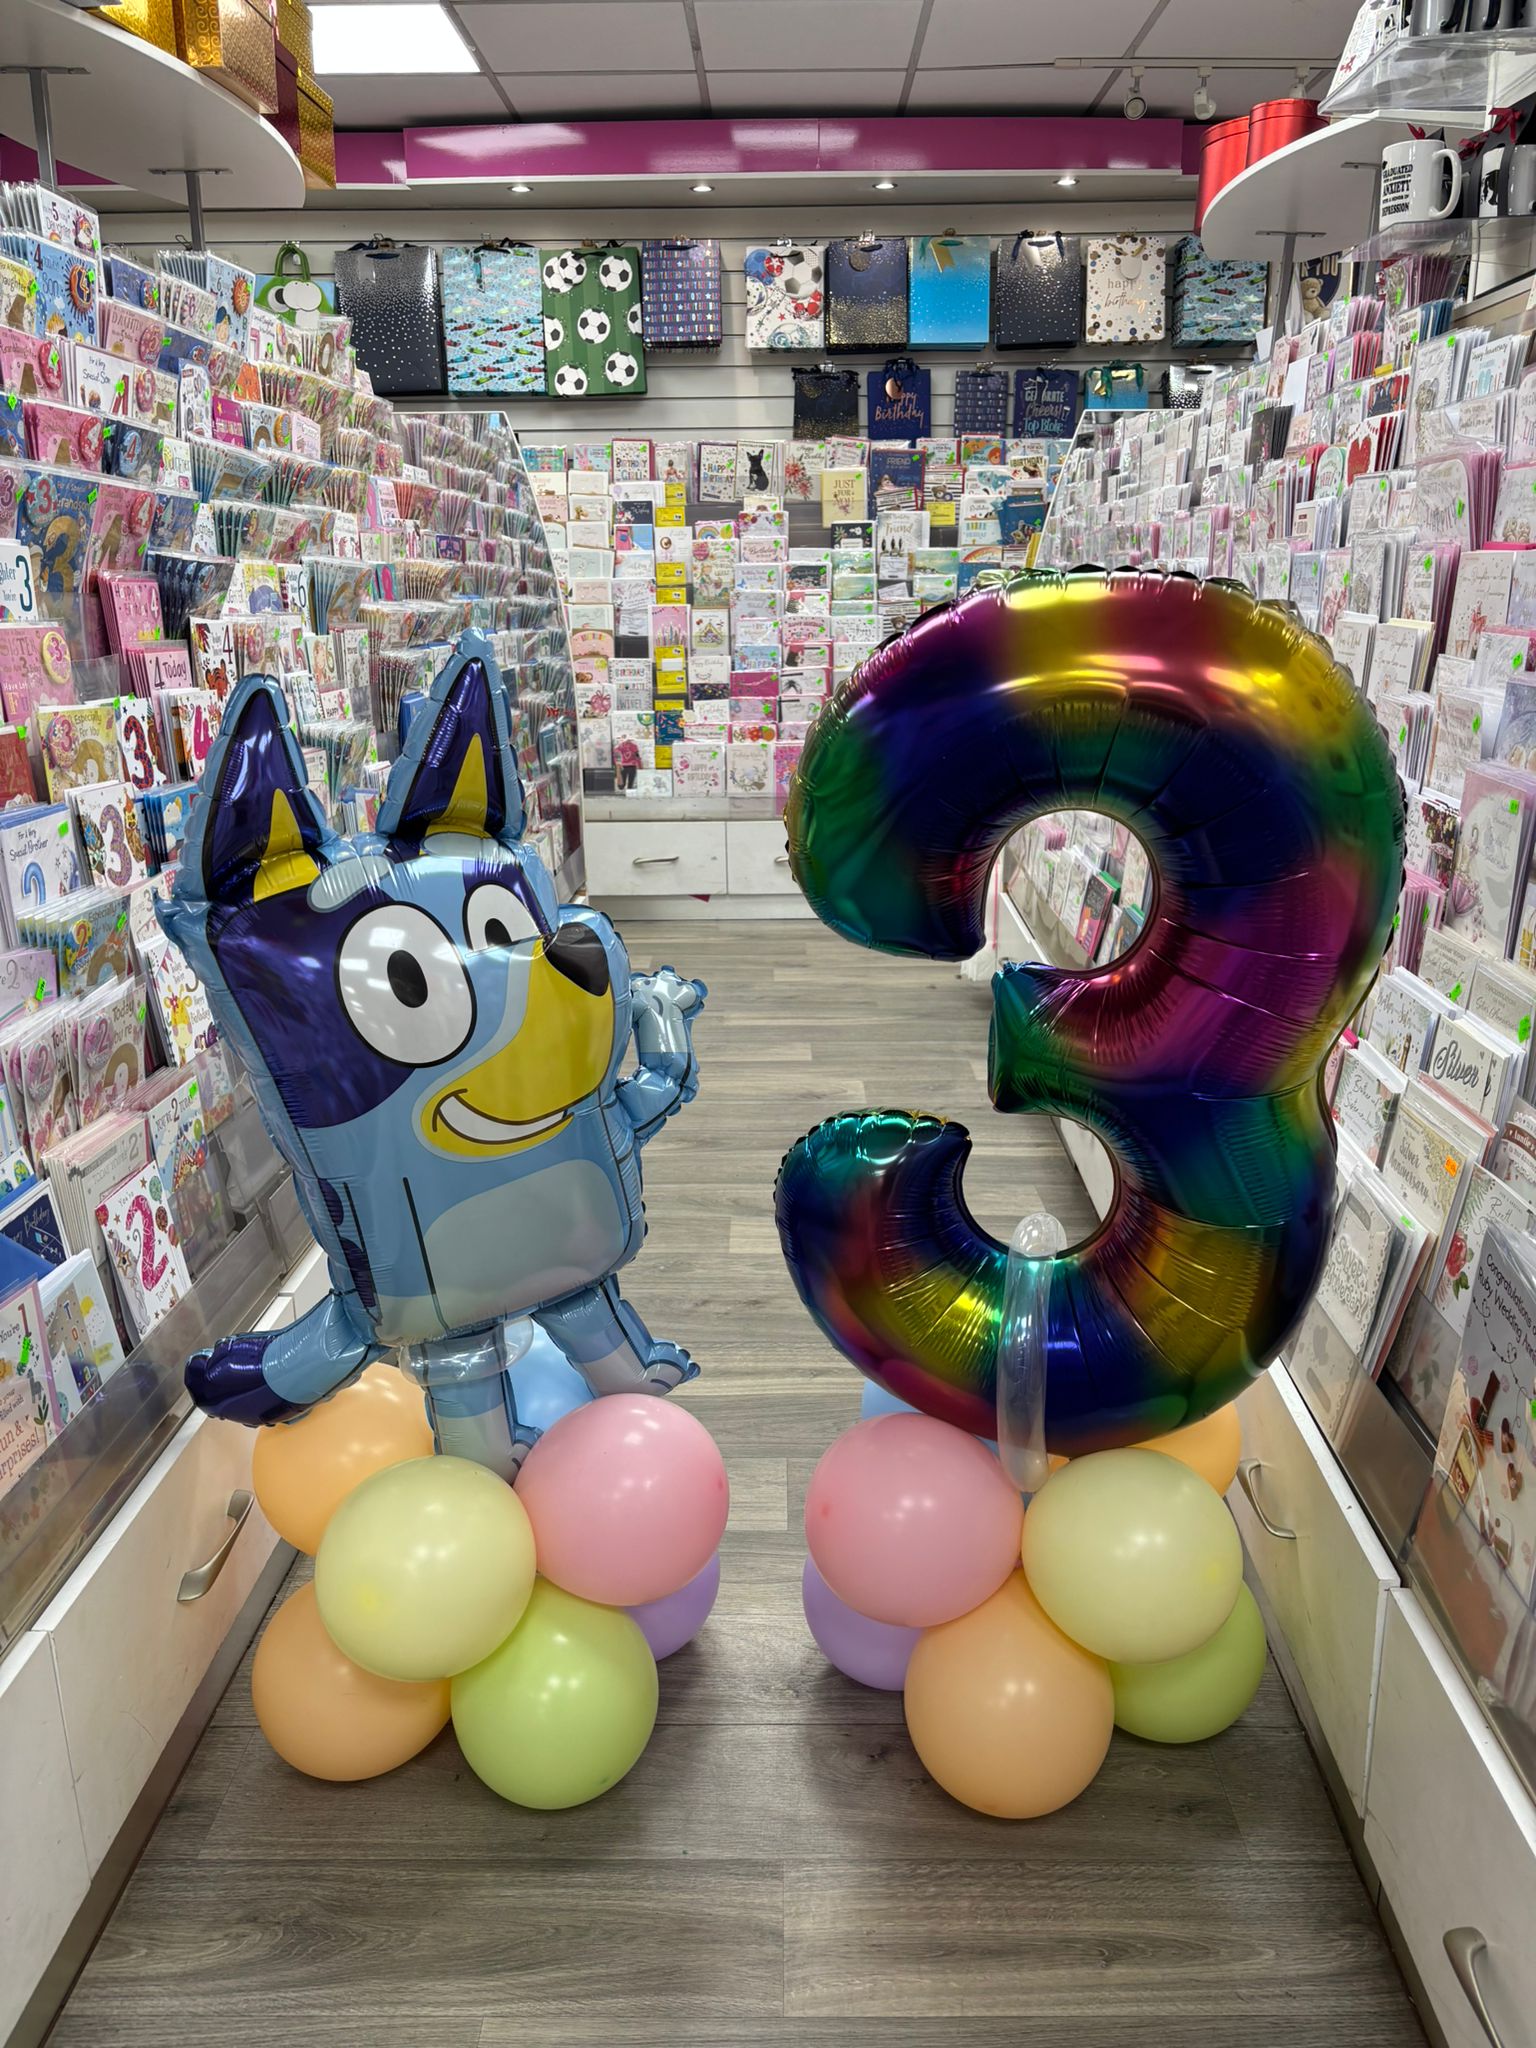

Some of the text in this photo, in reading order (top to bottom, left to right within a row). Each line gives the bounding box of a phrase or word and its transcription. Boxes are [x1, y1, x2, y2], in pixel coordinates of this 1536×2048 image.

[34, 243, 44, 271] 4
[42, 271, 60, 298] Son
[1107, 278, 1142, 292] happy
[875, 405, 924, 428] Birthday
[1023, 418, 1064, 434] Top Bloke
[1026, 402, 1063, 418] Cheers!
[127, 437, 137, 463] 4
[616, 457, 647, 468] BIRTHDAY
[38, 479, 51, 514] 3
[834, 480, 856, 489] JUST
[16, 554, 33, 612] 3
[150, 588, 159, 618] 4
[51, 636, 63, 661] 3
[222, 624, 233, 664] 4
[154, 655, 187, 690] 4 Today
[61, 719, 73, 752] 3
[123, 715, 154, 790] 3
[9, 839, 48, 861] Special Brother
[99, 804, 132, 887] 3
[76, 923, 88, 962] 2
[6, 959, 20, 990] 2
[112, 1004, 133, 1022] Today
[97, 1018, 108, 1053] 2
[38, 1045, 50, 1084] 2
[1433, 1040, 1479, 1088] Silver
[171, 1097, 180, 1122] 2
[128, 1133, 139, 1162] 2
[1400, 1136, 1420, 1169] Silver
[1389, 1149, 1430, 1204] Anniversary
[125, 1194, 169, 1291] 2
[1477, 1266, 1493, 1299] Ruby
[1494, 1289, 1523, 1344] Wedding
[1486, 1253, 1532, 1328] Congratulations
[0, 1323, 20, 1344] You're
[18, 1303, 32, 1337] 1
[0, 1419, 24, 1454] un &
